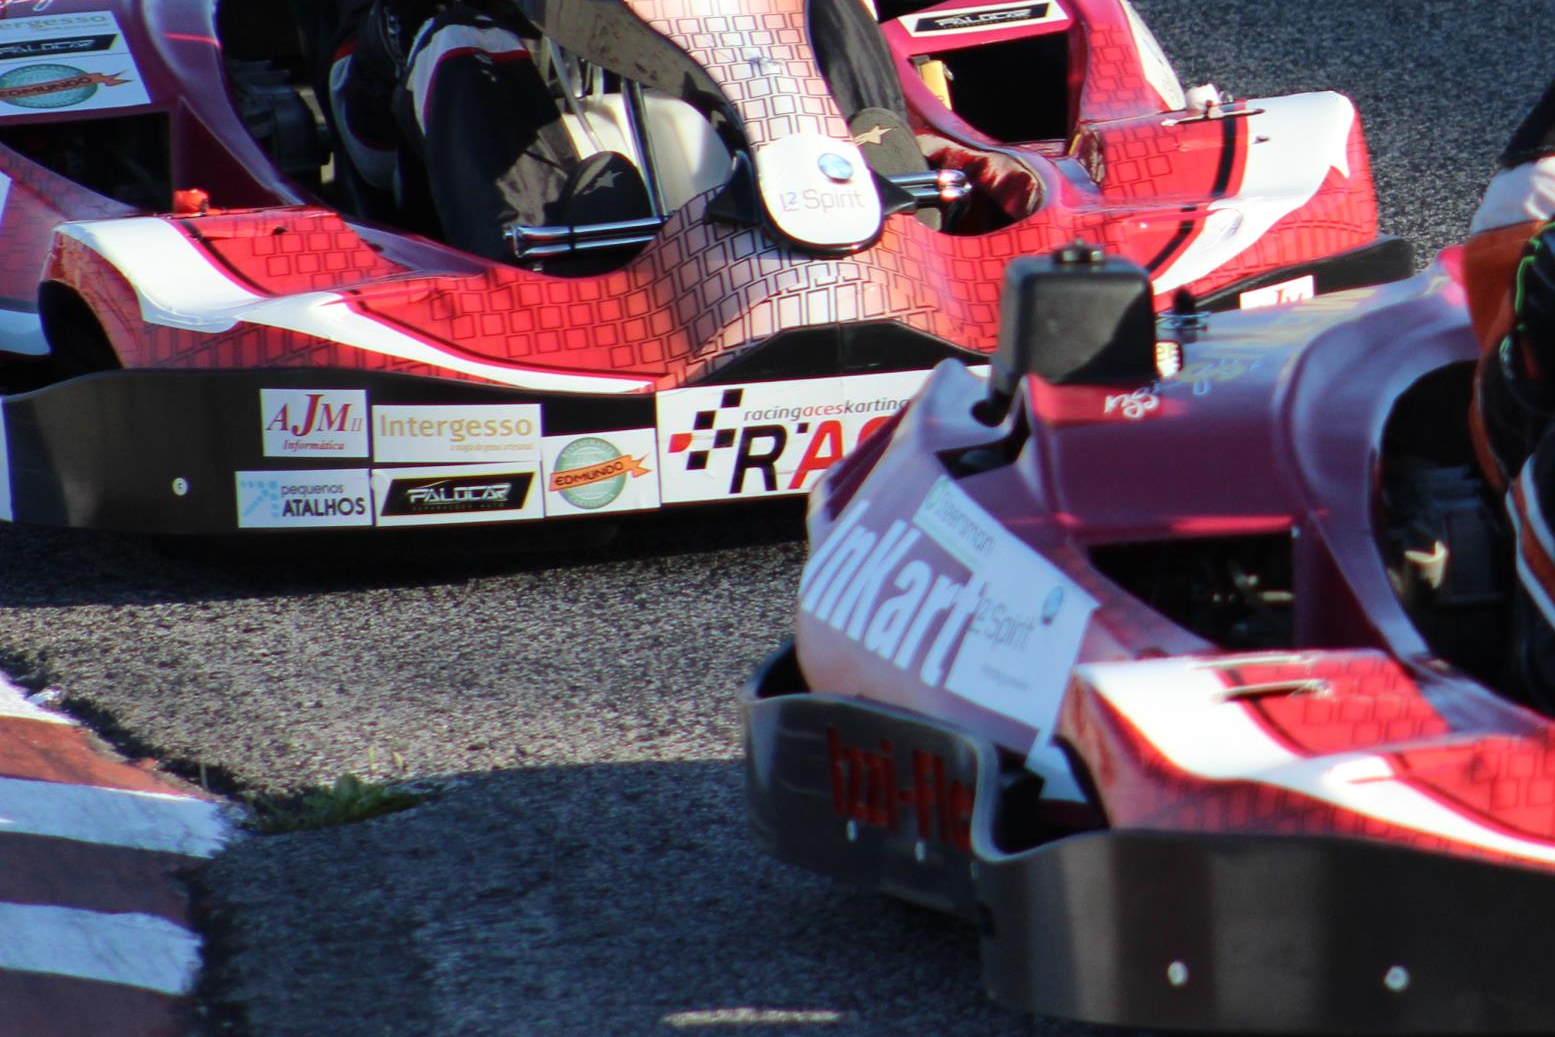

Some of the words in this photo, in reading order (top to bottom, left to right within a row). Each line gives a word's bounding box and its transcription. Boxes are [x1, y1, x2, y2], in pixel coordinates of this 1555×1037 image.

[266, 394, 352, 436] AJM
[380, 414, 533, 442] Intergesso
[283, 439, 345, 452] Informática
[554, 462, 624, 487] EDMUNDO
[281, 483, 345, 498] pequenos
[282, 497, 366, 517] ATALHOS
[801, 499, 986, 688] InKart
